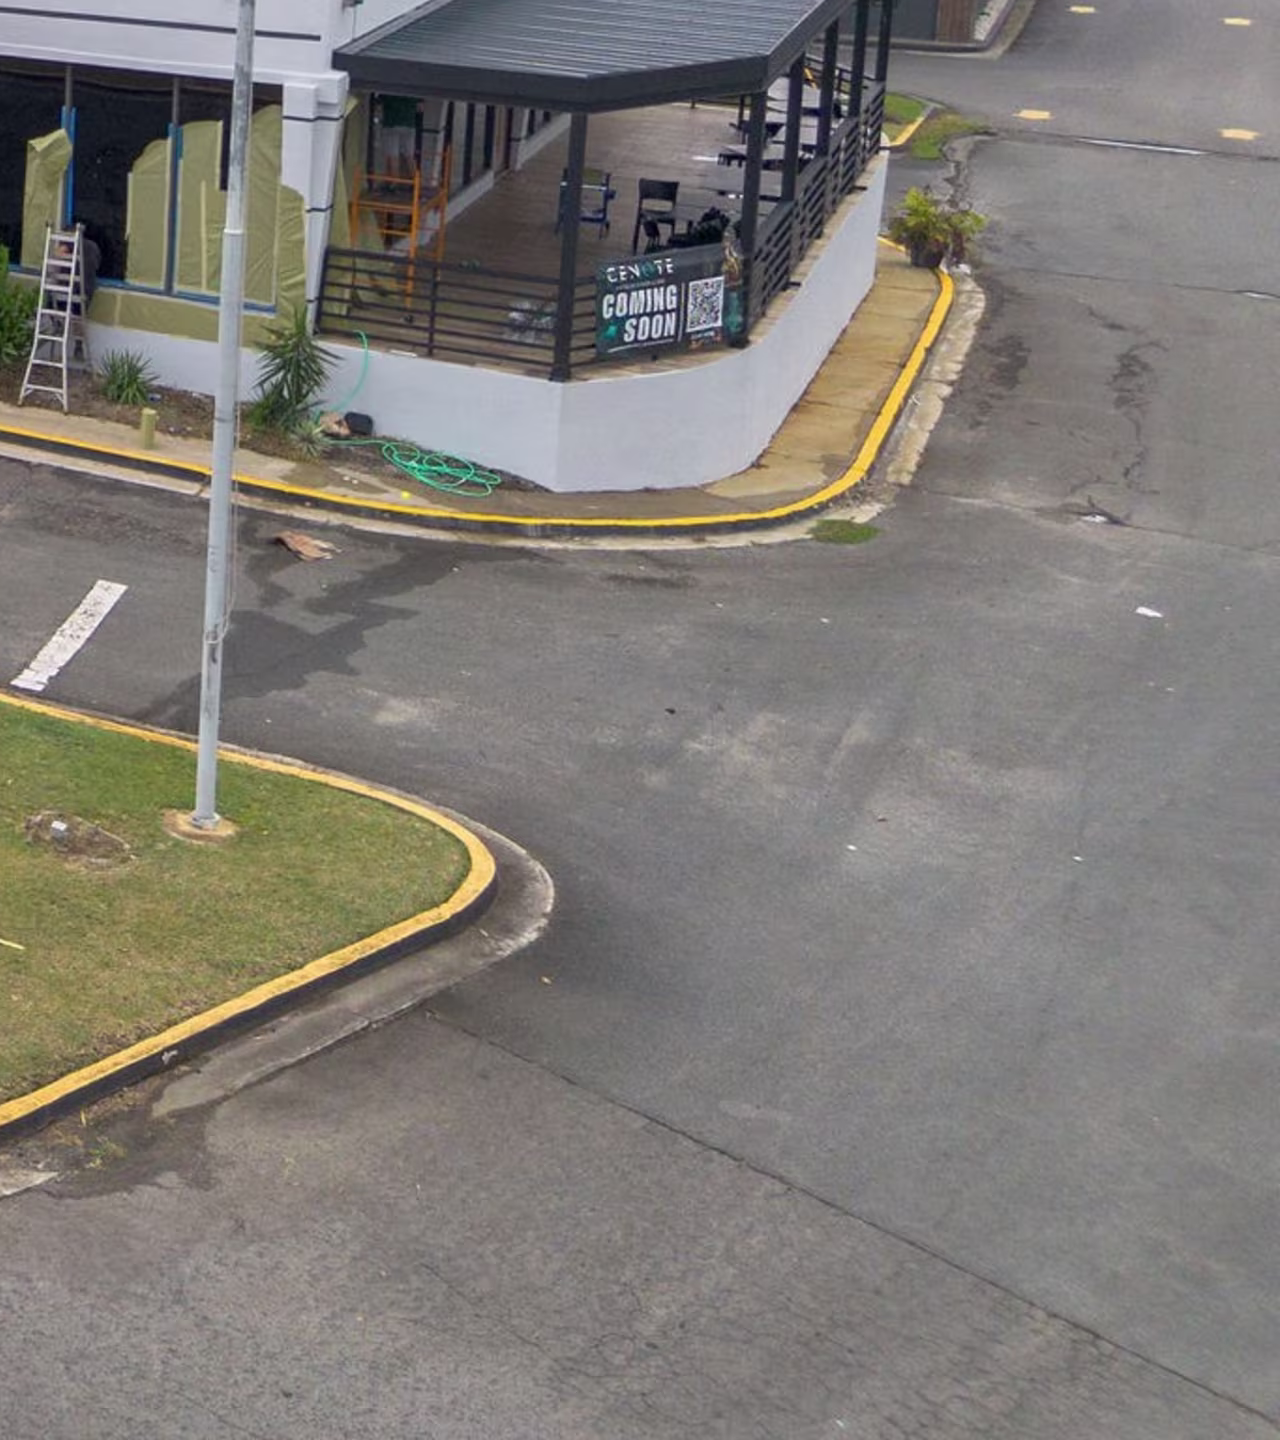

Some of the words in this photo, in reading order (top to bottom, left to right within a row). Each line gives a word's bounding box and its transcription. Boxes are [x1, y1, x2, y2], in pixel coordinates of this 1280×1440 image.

[606, 257, 674, 283] CENOTE
[602, 284, 678, 319] COMING
[623, 312, 677, 343] SOON
